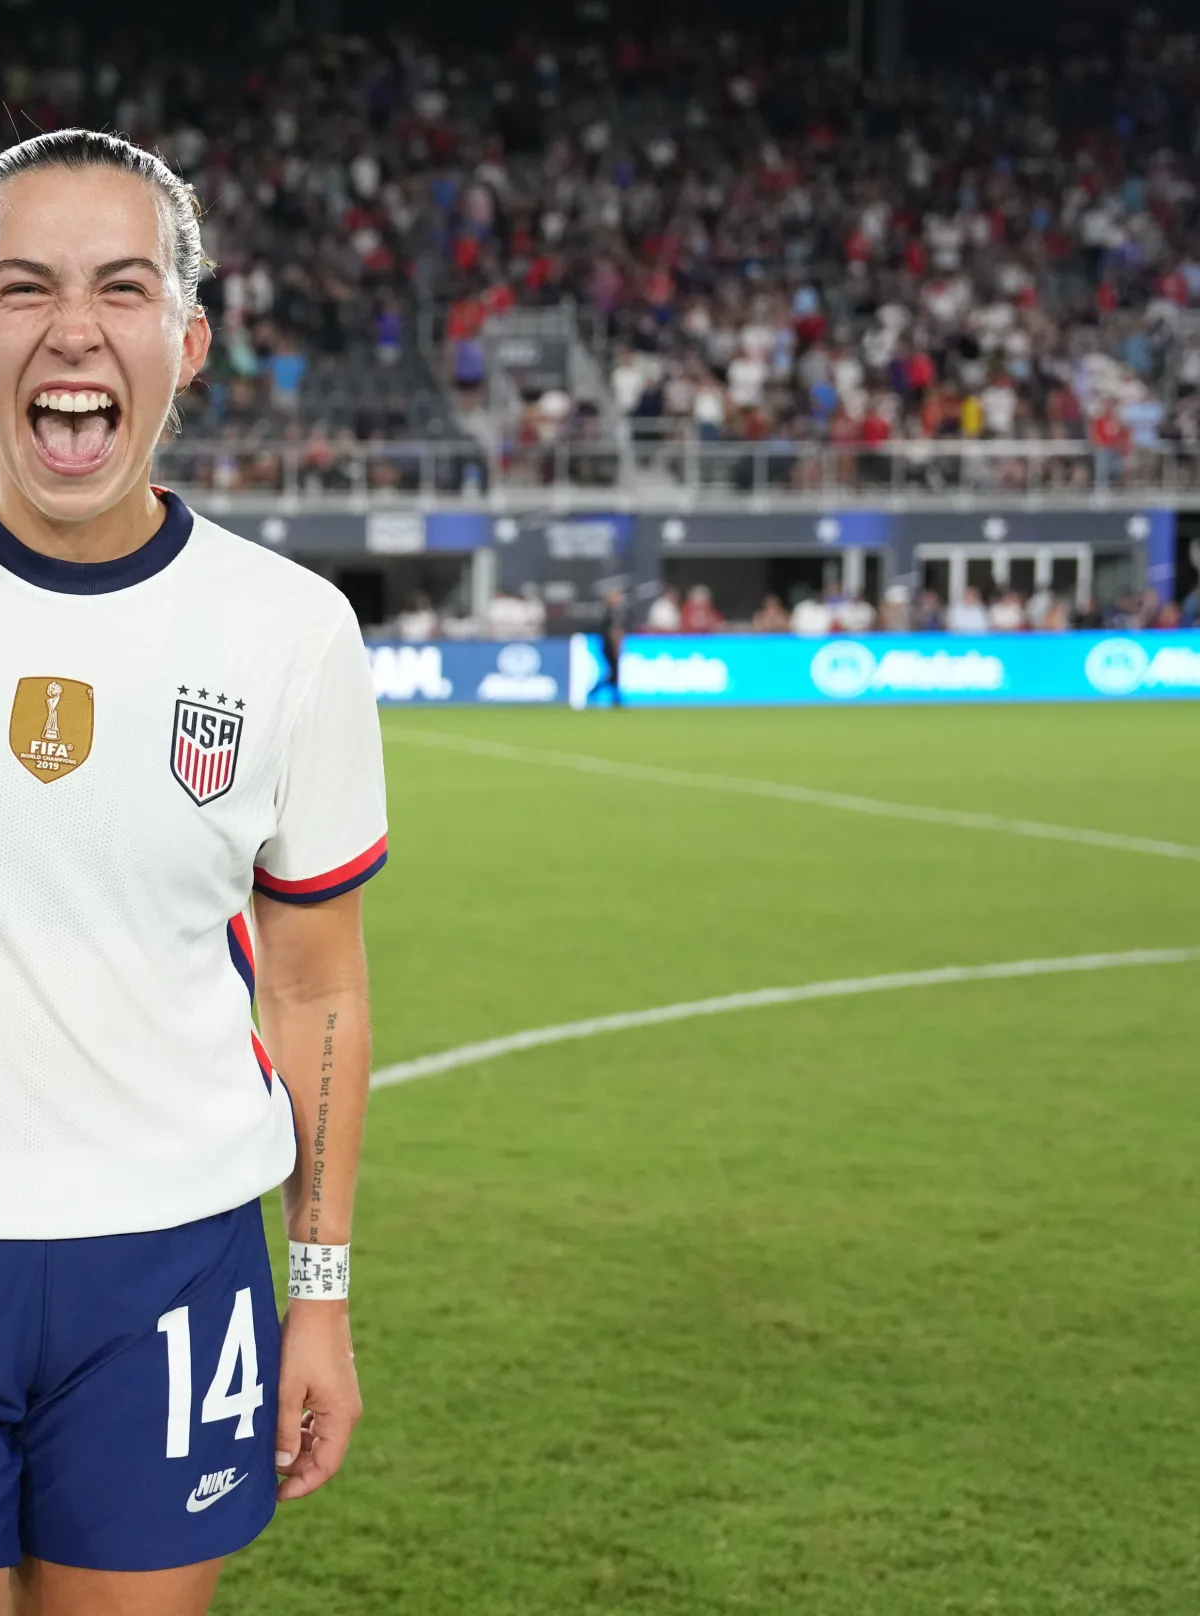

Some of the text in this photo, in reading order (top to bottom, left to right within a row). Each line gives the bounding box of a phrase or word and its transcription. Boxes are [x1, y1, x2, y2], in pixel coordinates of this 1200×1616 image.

[181, 709, 235, 748] USA
[36, 761, 59, 770] 2019
[42, 756, 77, 765] CHAMPIONS
[327, 1012, 337, 1031] Yet
[323, 1036, 332, 1056] not
[320, 1077, 331, 1097] but
[315, 1102, 328, 1155] through
[312, 1161, 324, 1202] Christ
[310, 1208, 320, 1222] in
[321, 1248, 333, 1293] NO FEAR
[157, 1287, 264, 1459] 14
[196, 1467, 237, 1497] NIKE
